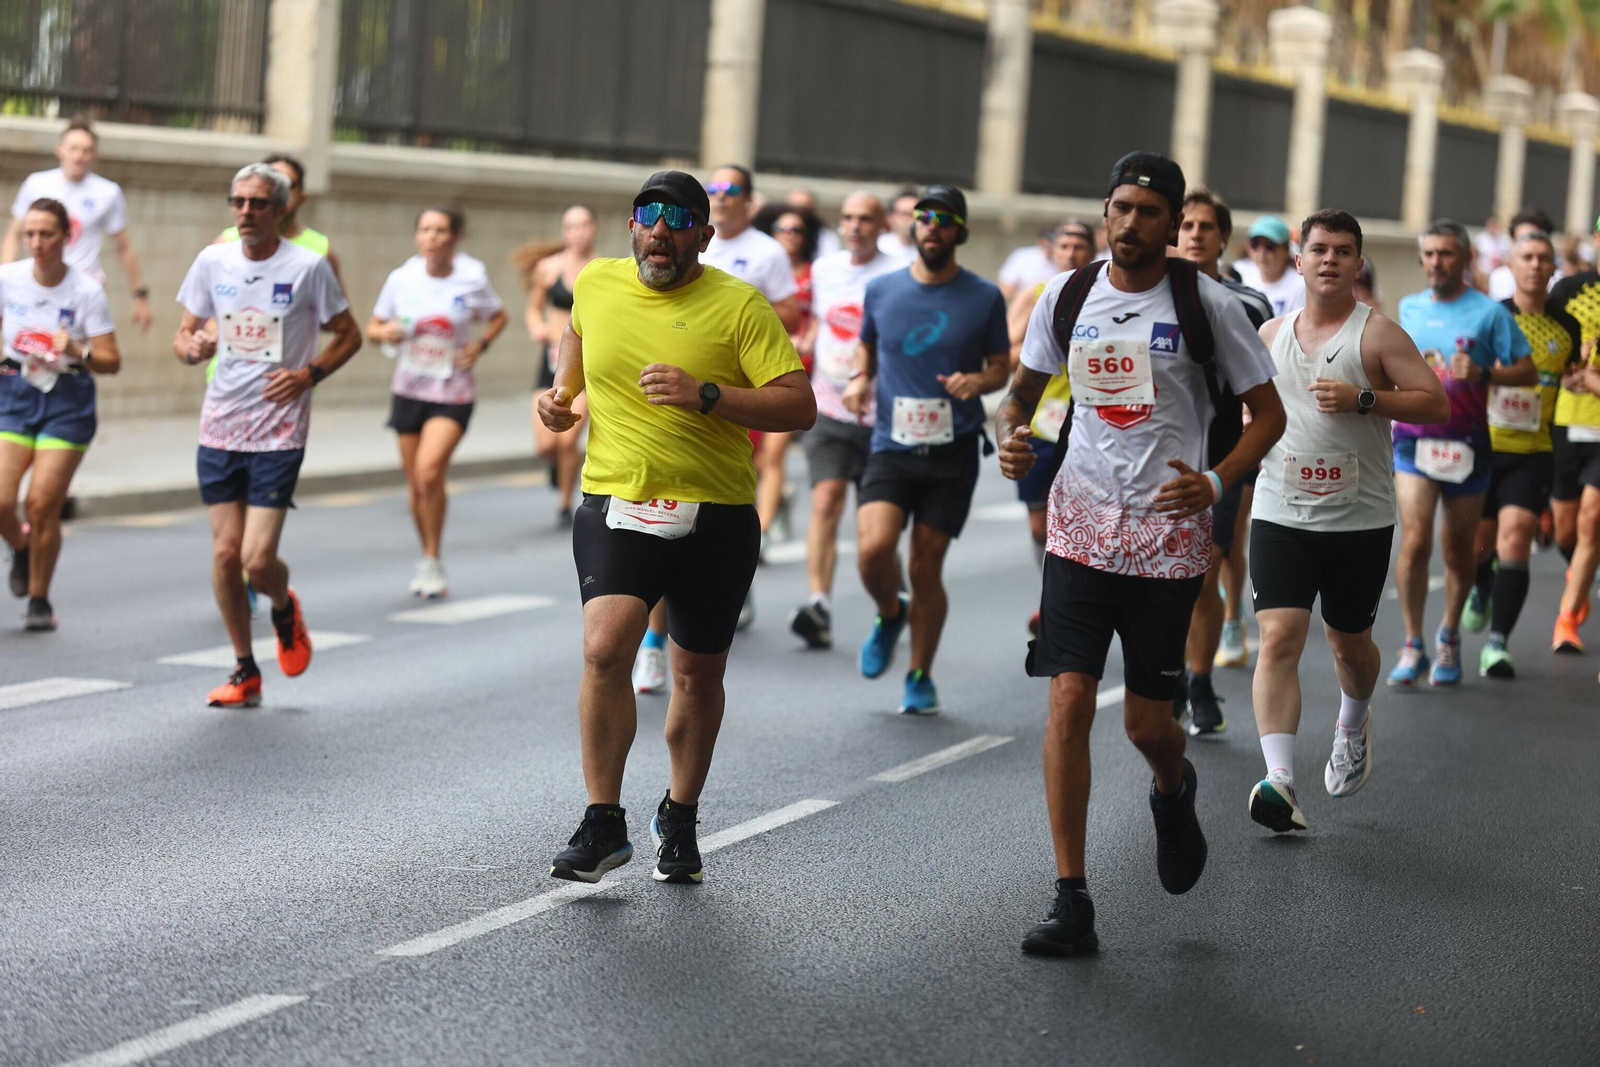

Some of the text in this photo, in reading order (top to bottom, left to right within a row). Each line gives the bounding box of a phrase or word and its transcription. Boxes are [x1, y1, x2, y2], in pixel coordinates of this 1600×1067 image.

[235, 325, 267, 338] 122
[1150, 337, 1174, 350] AXA
[1088, 356, 1134, 374] 560
[1301, 467, 1341, 480] 998
[632, 498, 678, 511] 19
[658, 510, 680, 519] BECERRA
